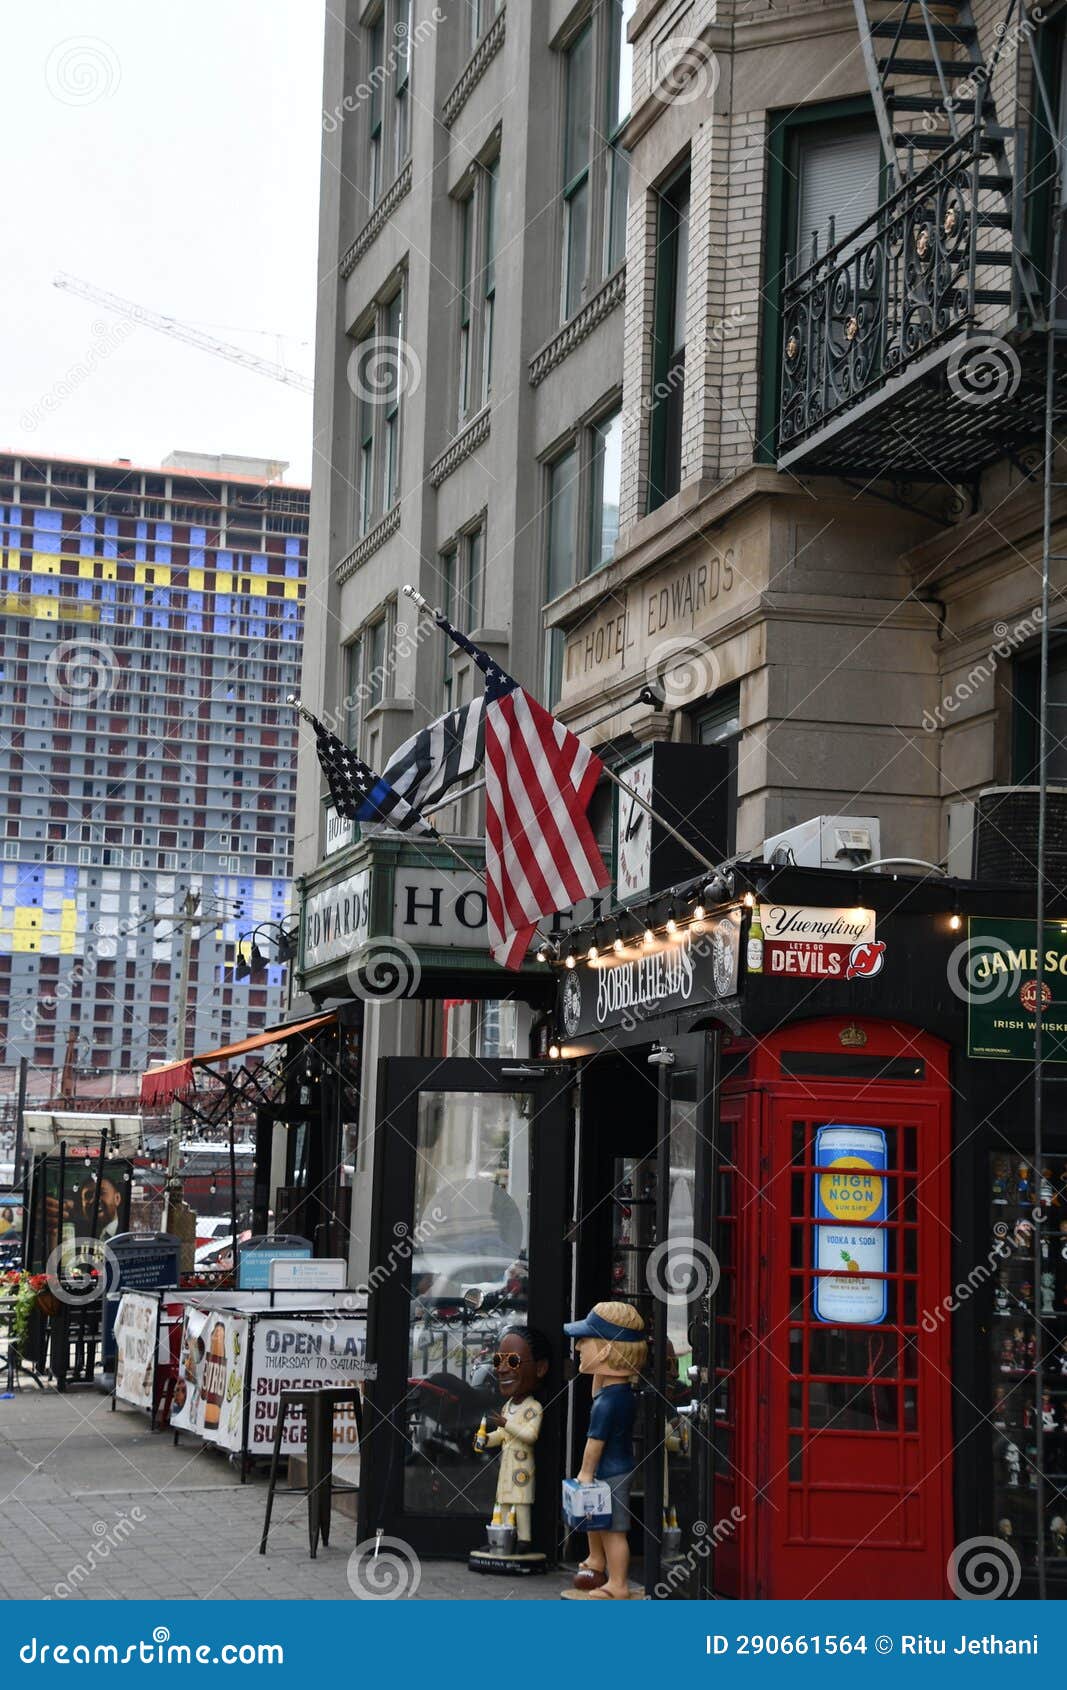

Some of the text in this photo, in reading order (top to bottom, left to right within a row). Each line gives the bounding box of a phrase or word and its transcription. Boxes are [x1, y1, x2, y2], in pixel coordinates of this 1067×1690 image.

[585, 549, 735, 673] HOTEL EDWARDS
[306, 887, 369, 949] EDWARDS
[404, 886, 603, 936] HOE
[766, 907, 871, 940] Yuengling
[772, 950, 841, 975] DEVILS
[597, 929, 693, 1023] BOBBLEHEADS
[994, 1020, 1024, 1029] IRISH
[832, 1175, 872, 1187] HIGH
[829, 1189, 873, 1201] NOON
[827, 1236, 876, 1246] VODKA & SODA
[266, 1330, 322, 1354] OPEN
[265, 1355, 314, 1368] THURSDAY
[316, 1357, 327, 1368] TO
